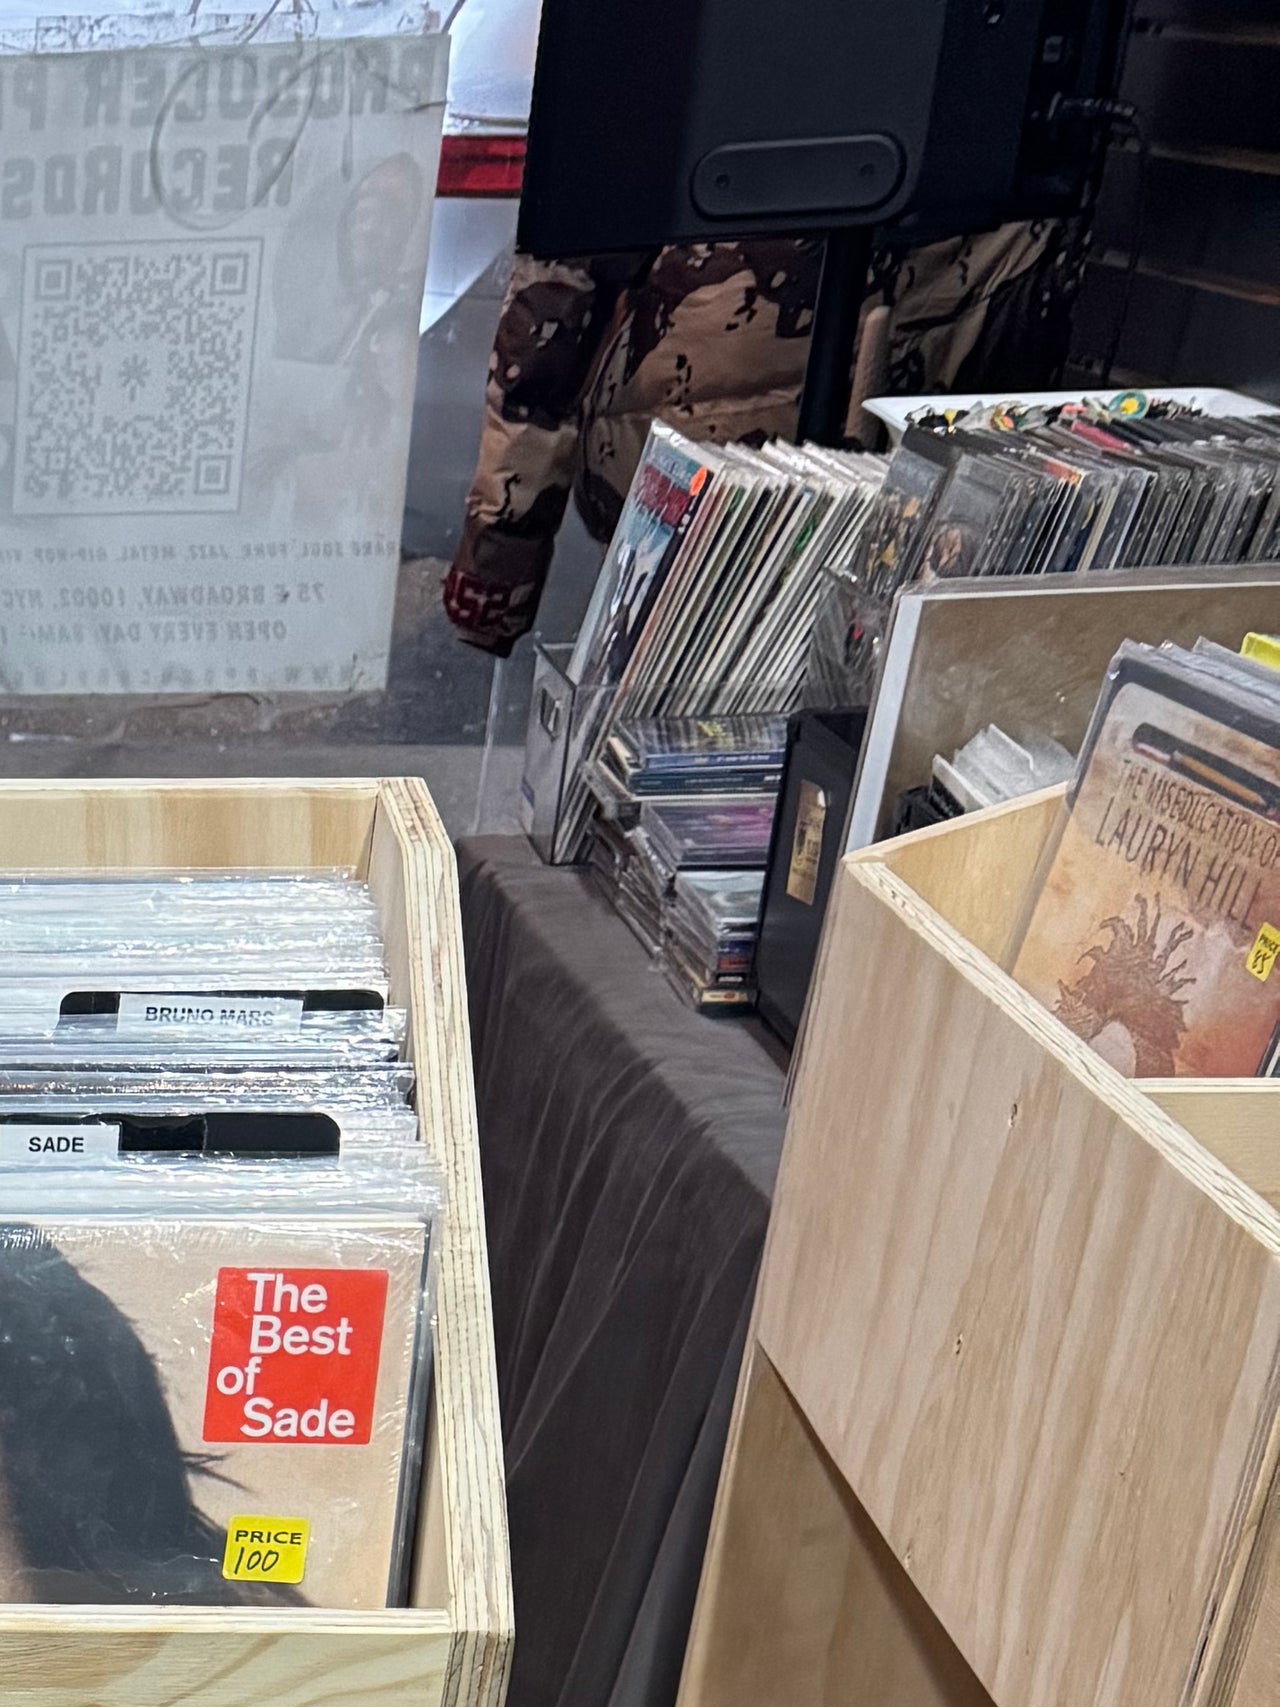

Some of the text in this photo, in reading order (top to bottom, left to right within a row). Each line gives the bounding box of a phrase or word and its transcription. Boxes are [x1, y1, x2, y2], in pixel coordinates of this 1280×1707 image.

[1121, 758, 1149, 800] THE
[1146, 768, 1260, 858] MISEDUCATION
[1095, 796, 1263, 932] LAURYN HILL
[144, 1005, 275, 1028] BRUNO MARS
[27, 1136, 85, 1154] SADE
[246, 1273, 328, 1314] The
[249, 1315, 354, 1356] Best
[216, 1356, 263, 1395] of
[239, 1397, 356, 1439] Sade
[235, 1529, 303, 1545] PRICE
[234, 1546, 279, 1576] 100
